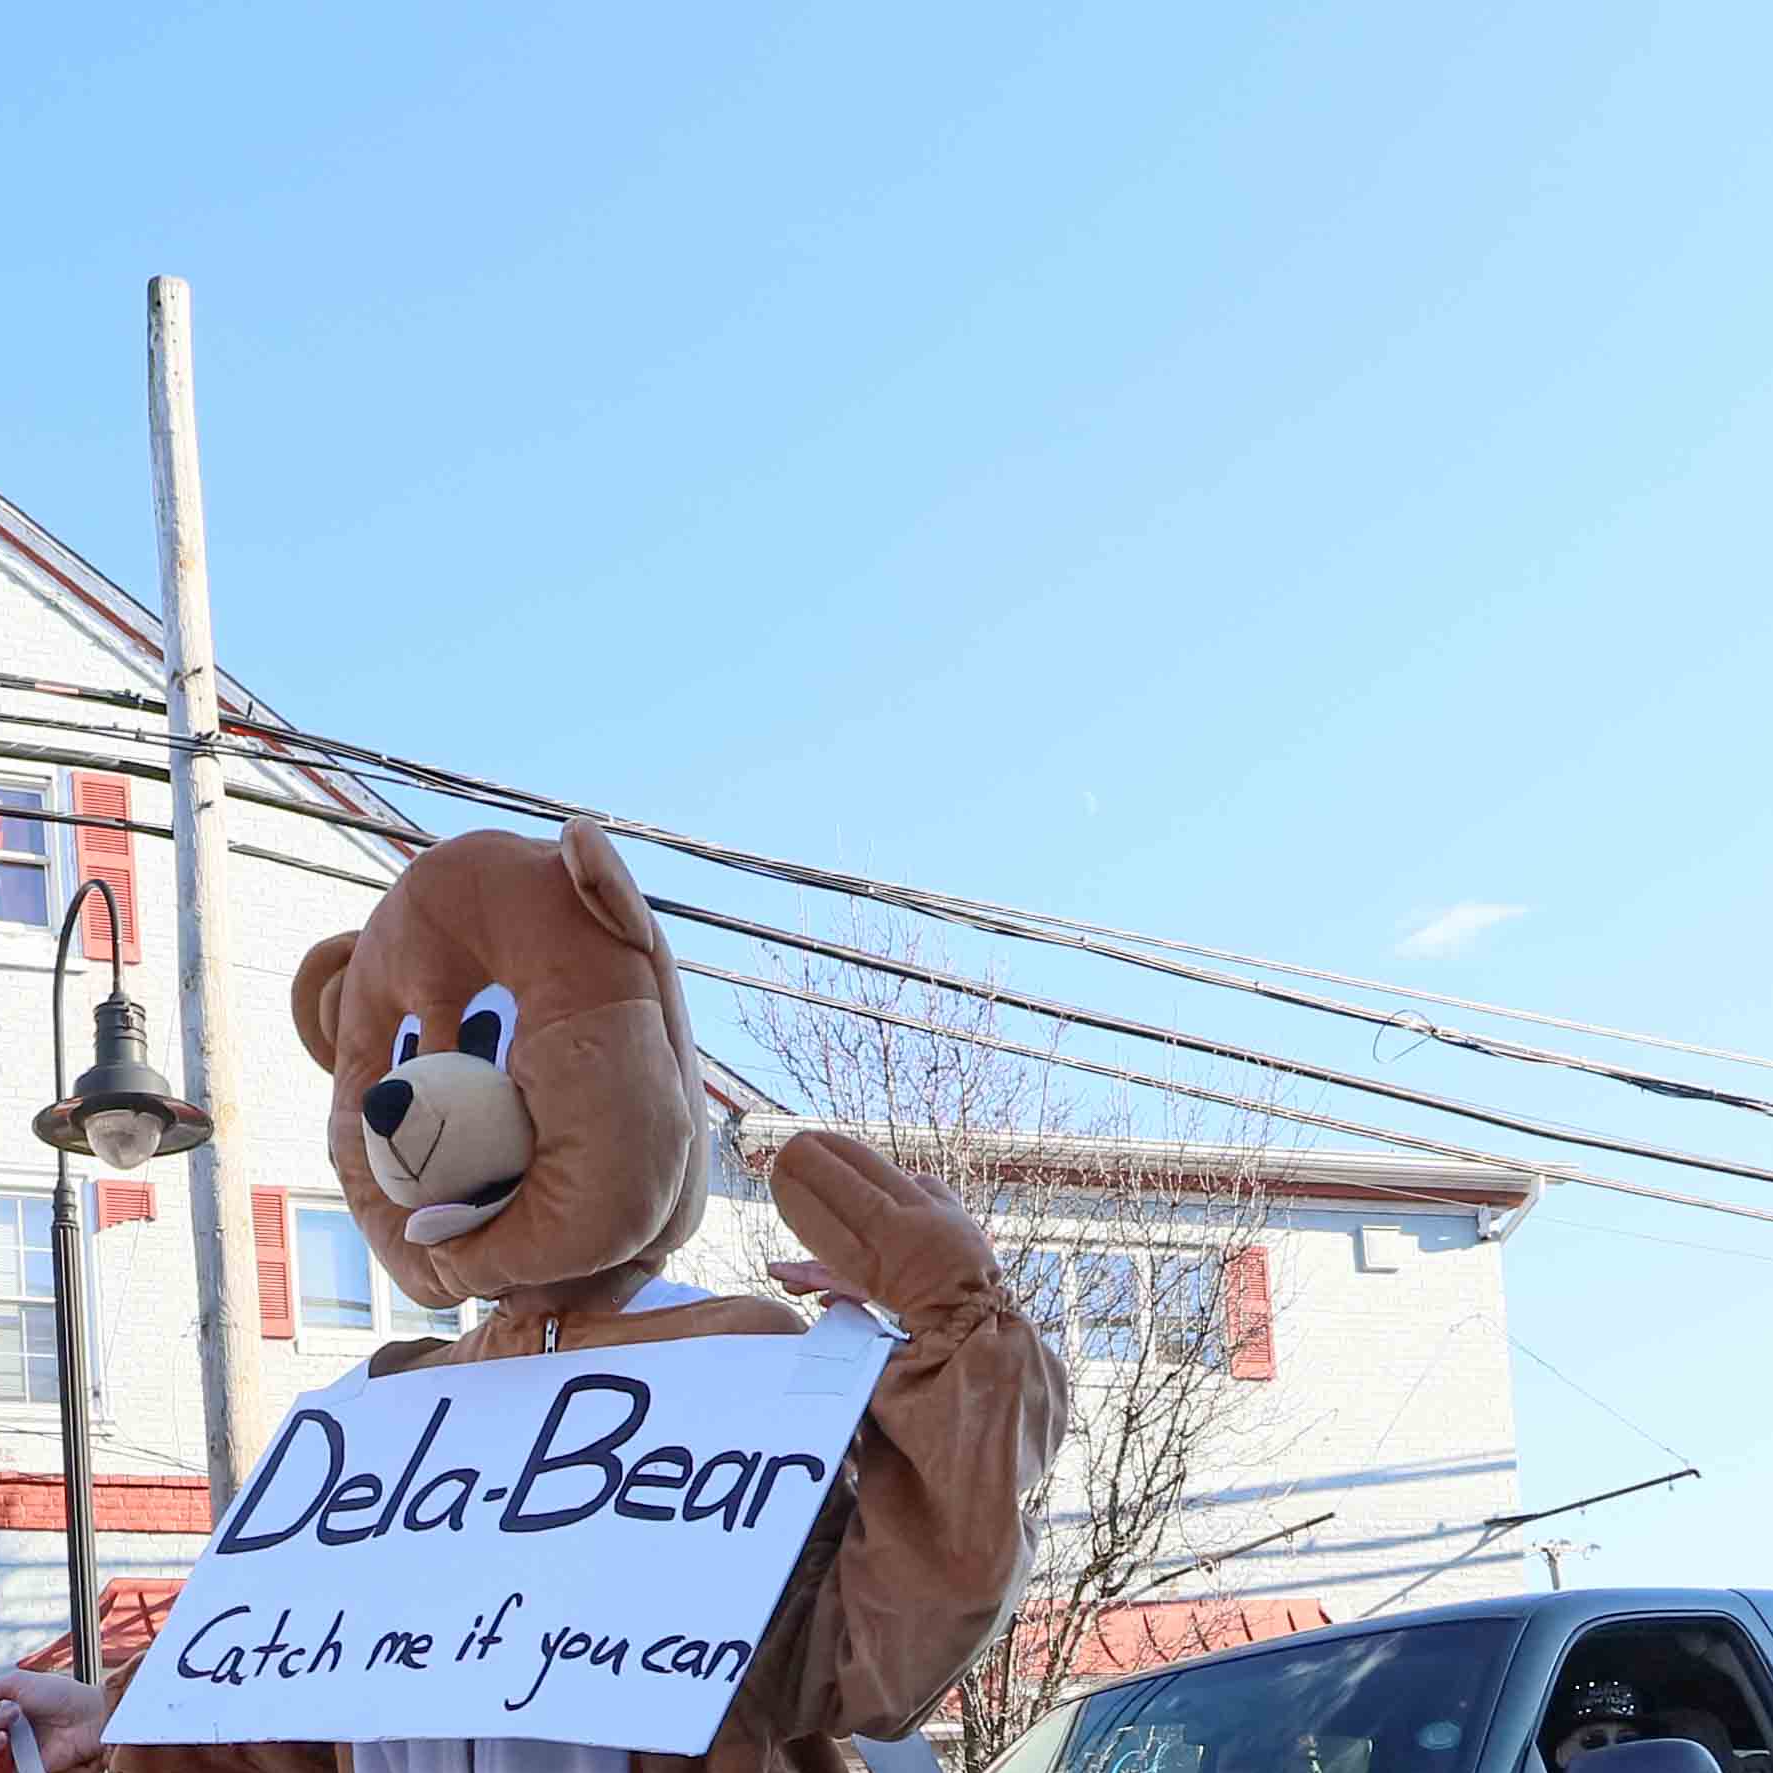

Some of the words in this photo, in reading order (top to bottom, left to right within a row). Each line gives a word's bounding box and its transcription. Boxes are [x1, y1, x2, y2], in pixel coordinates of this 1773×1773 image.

[216, 1373, 825, 1555] Dela-Bear
[177, 1605, 344, 1685] Catch
[365, 1630, 433, 1672] me
[455, 1593, 523, 1662] if
[504, 1625, 629, 1711] you
[641, 1633, 754, 1683] can
